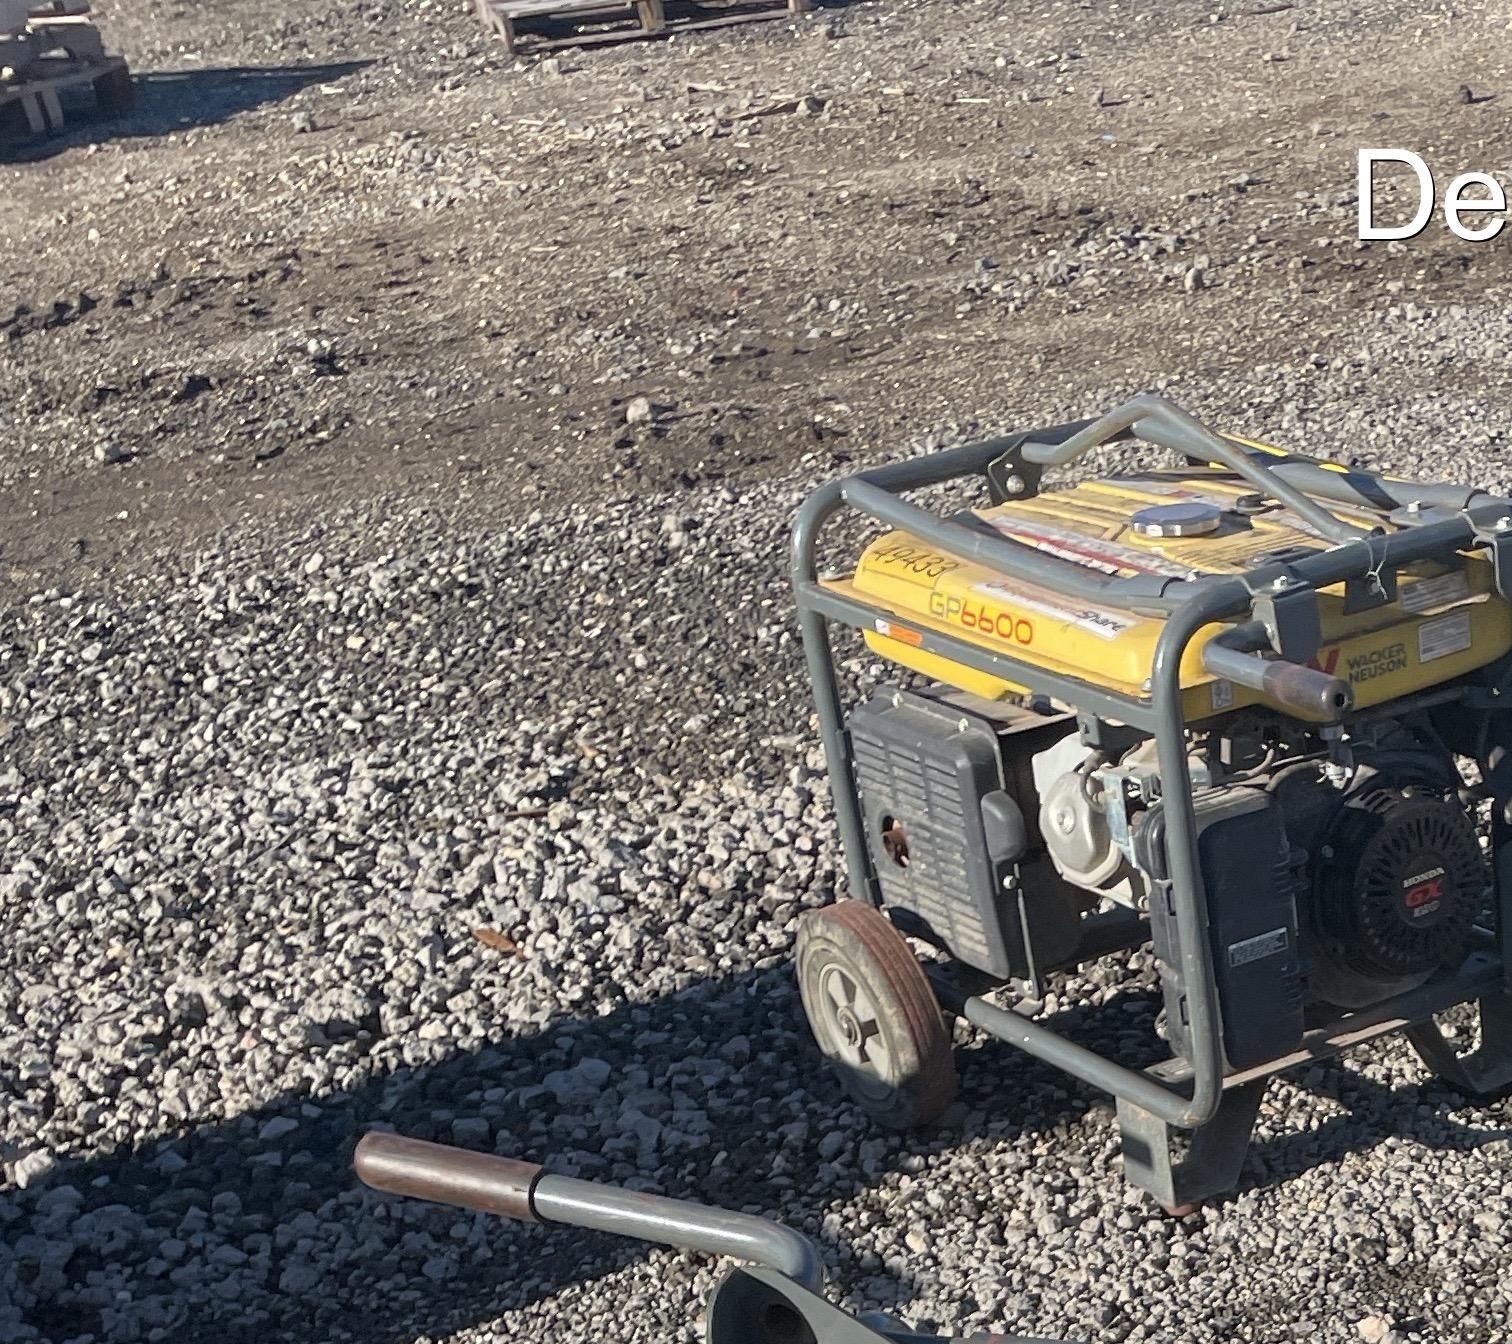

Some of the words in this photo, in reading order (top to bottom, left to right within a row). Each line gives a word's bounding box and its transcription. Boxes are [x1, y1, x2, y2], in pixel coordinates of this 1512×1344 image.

[929, 591, 1034, 645] GP6600
[1347, 643, 1406, 670] WACKER
[1348, 658, 1408, 683] NEUSON
